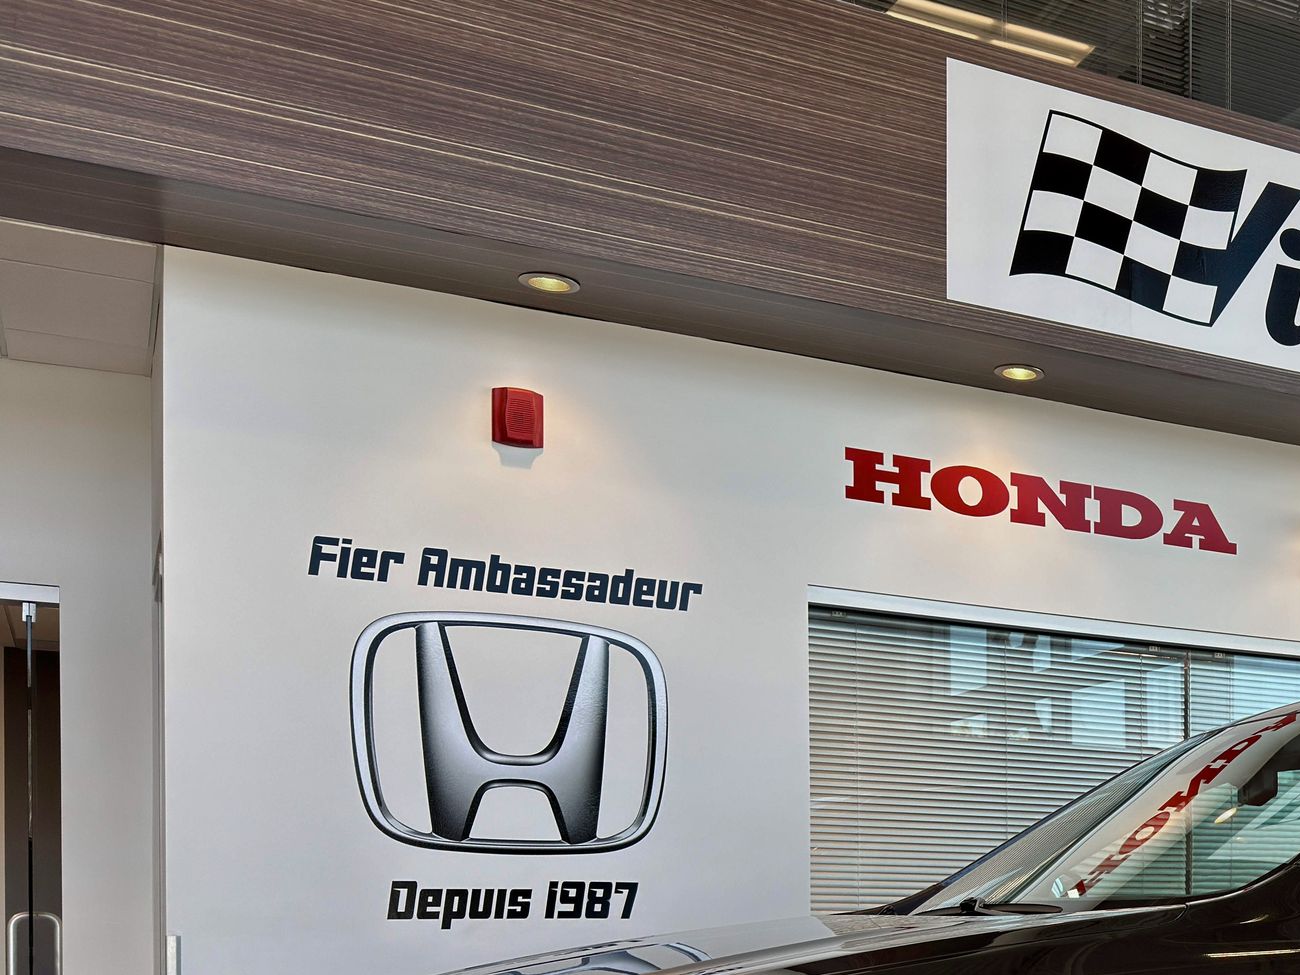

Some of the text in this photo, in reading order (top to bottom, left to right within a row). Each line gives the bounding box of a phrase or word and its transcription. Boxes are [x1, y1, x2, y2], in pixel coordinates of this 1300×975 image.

[845, 447, 1237, 555] HONDA
[308, 536, 703, 611] Fier Ambassadeur
[387, 880, 533, 930] Depuis
